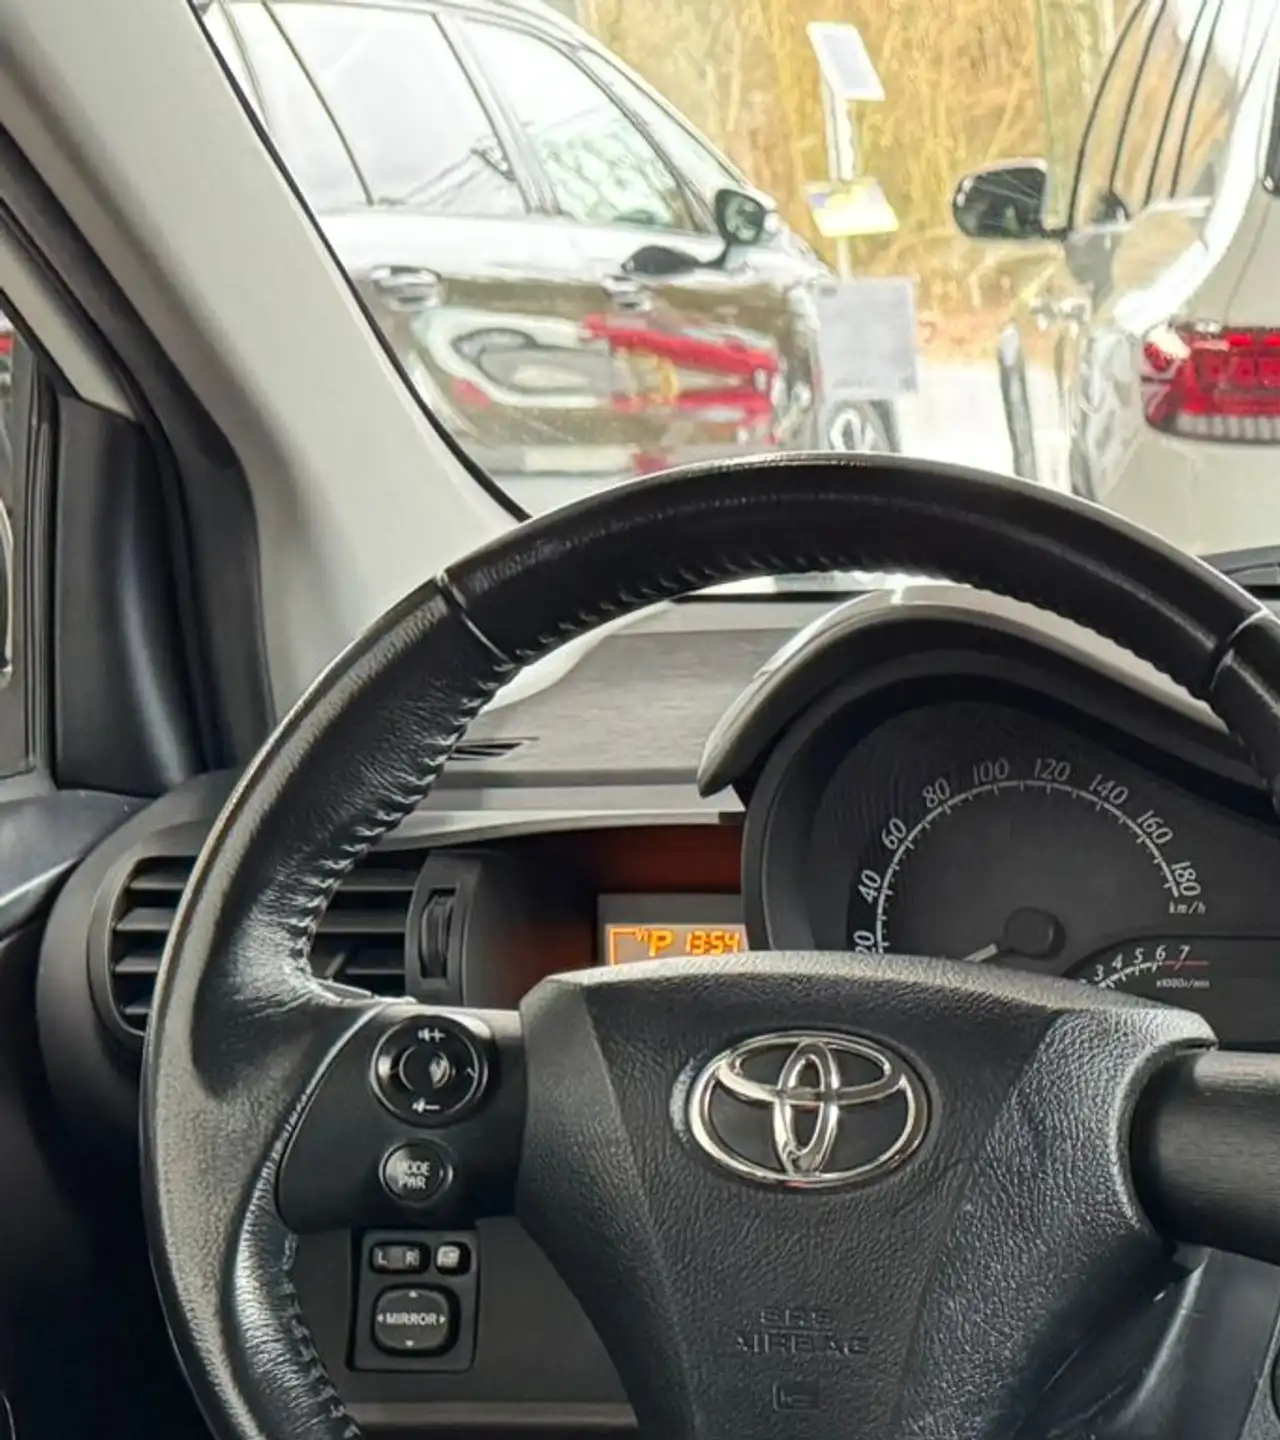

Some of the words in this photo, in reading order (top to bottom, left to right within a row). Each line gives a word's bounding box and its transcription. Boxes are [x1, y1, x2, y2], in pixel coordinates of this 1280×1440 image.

[858, 870, 881, 904] 40
[881, 817, 907, 850] 60
[922, 777, 950, 809] 80
[973, 757, 1010, 786] 100
[1034, 757, 1071, 782] 120
[1089, 773, 1129, 805] 140
[1136, 810, 1173, 844] 160
[1170, 861, 1201, 896] 180
[1168, 901, 1207, 915] km/h
[648, 929, 674, 957] P
[1093, 964, 1105, 982] 3
[1111, 952, 1123, 971] 4
[1132, 947, 1145, 964] 5
[1155, 944, 1167, 961] 6
[1180, 944, 1192, 961] 7
[377, 1250, 389, 1265] L
[405, 1250, 417, 1266] R
[386, 1312, 438, 1326] MIRROR
